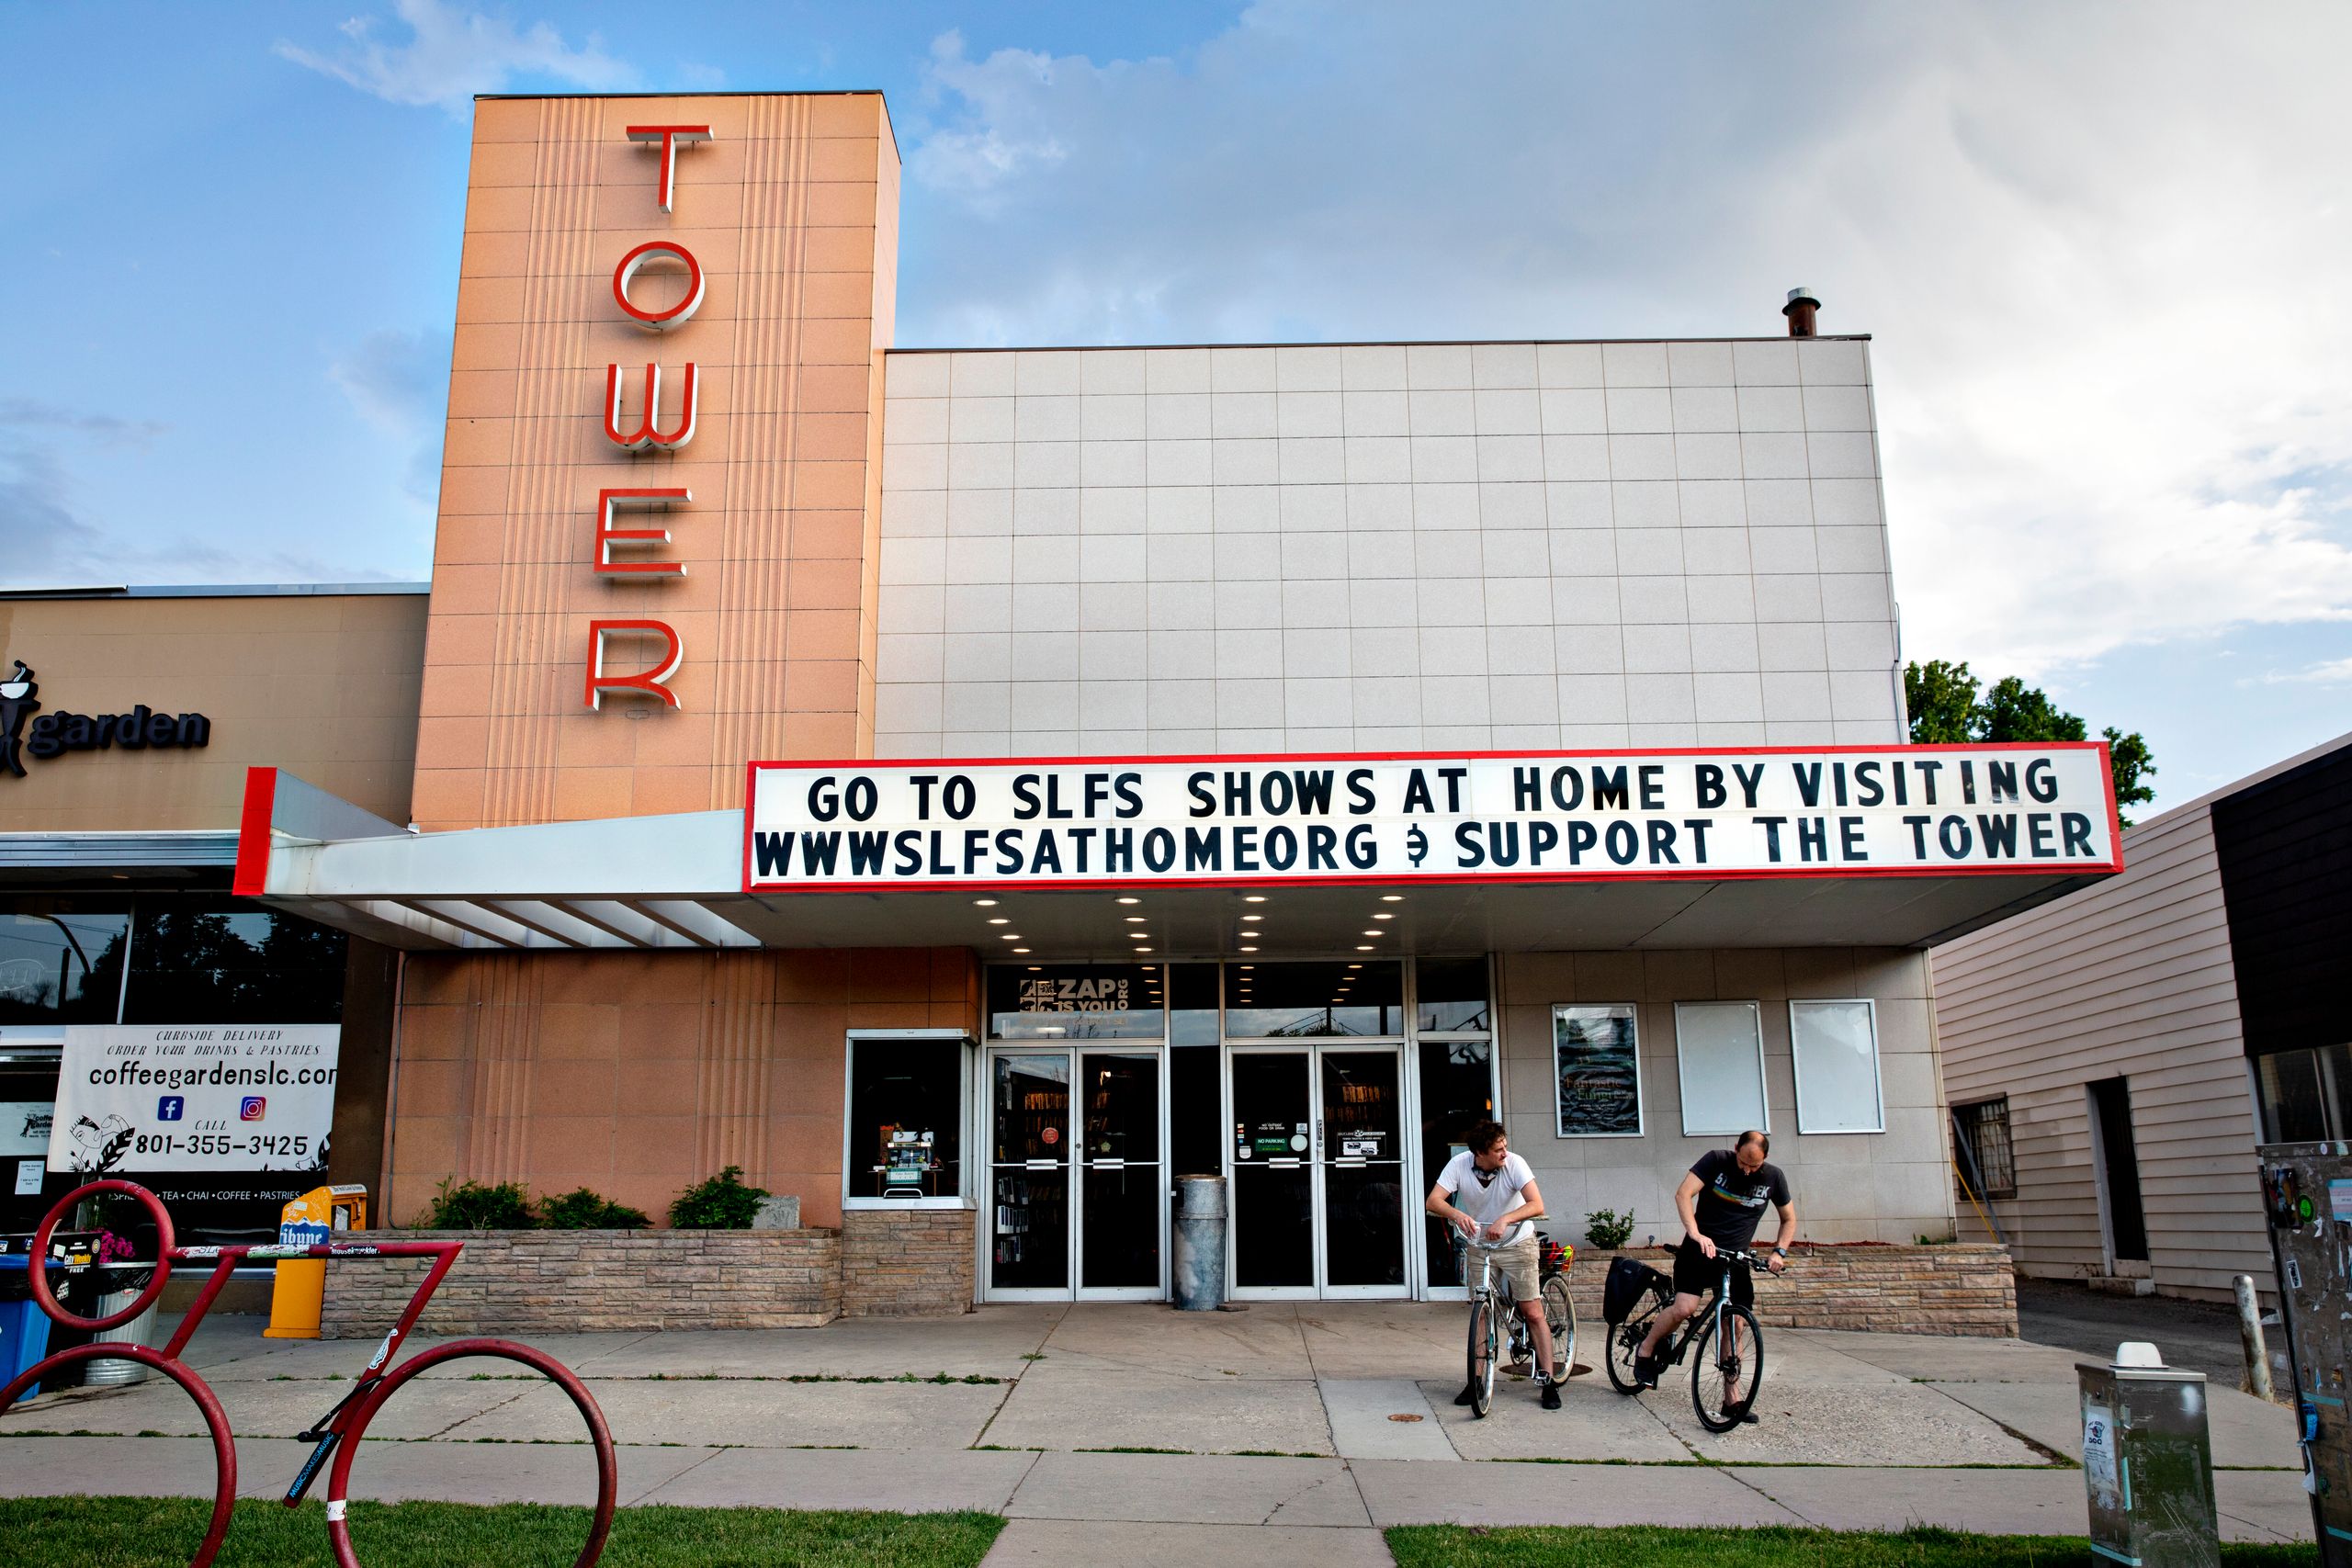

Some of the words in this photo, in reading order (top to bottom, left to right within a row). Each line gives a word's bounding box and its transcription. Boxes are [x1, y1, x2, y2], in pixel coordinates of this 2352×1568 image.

[584, 125, 715, 712] TOWER
[28, 705, 210, 759] garden
[808, 776, 878, 822] GO
[910, 774, 977, 820] TO
[1012, 773, 1144, 820] SLFS
[1188, 769, 1376, 818] SHOWS
[1403, 767, 1467, 814] AT
[1514, 765, 1665, 812] HOME
[1695, 763, 1765, 809] BY
[1792, 758, 2059, 807] VISITING
[754, 823, 1378, 877] WWWSLFSATHOMEORG
[1455, 819, 1713, 867] SUPPORT
[1753, 816, 1869, 862] THE
[1903, 812, 2097, 860] TOWER
[1057, 978, 1116, 998] ZAP
[1117, 978, 1129, 1011] ORG
[1058, 1000, 1075, 1013] IS
[1077, 1000, 1115, 1013] YOU
[156, 1030, 215, 1042] CURBSIDE
[222, 1030, 285, 1042] DELIVERY
[107, 1044, 147, 1055] ORDER
[155, 1044, 186, 1055] YOUR
[194, 1044, 238, 1055] DRINKS
[246, 1045, 254, 1055] &
[260, 1044, 321, 1055] PASTRIES
[195, 1120, 227, 1132] CALL
[135, 1134, 309, 1156] 801-355-3425
[163, 1190, 179, 1201] TEA
[187, 1190, 209, 1201] CHAI
[217, 1190, 251, 1201] COFFEE
[260, 1190, 300, 1201] PASTRIES
